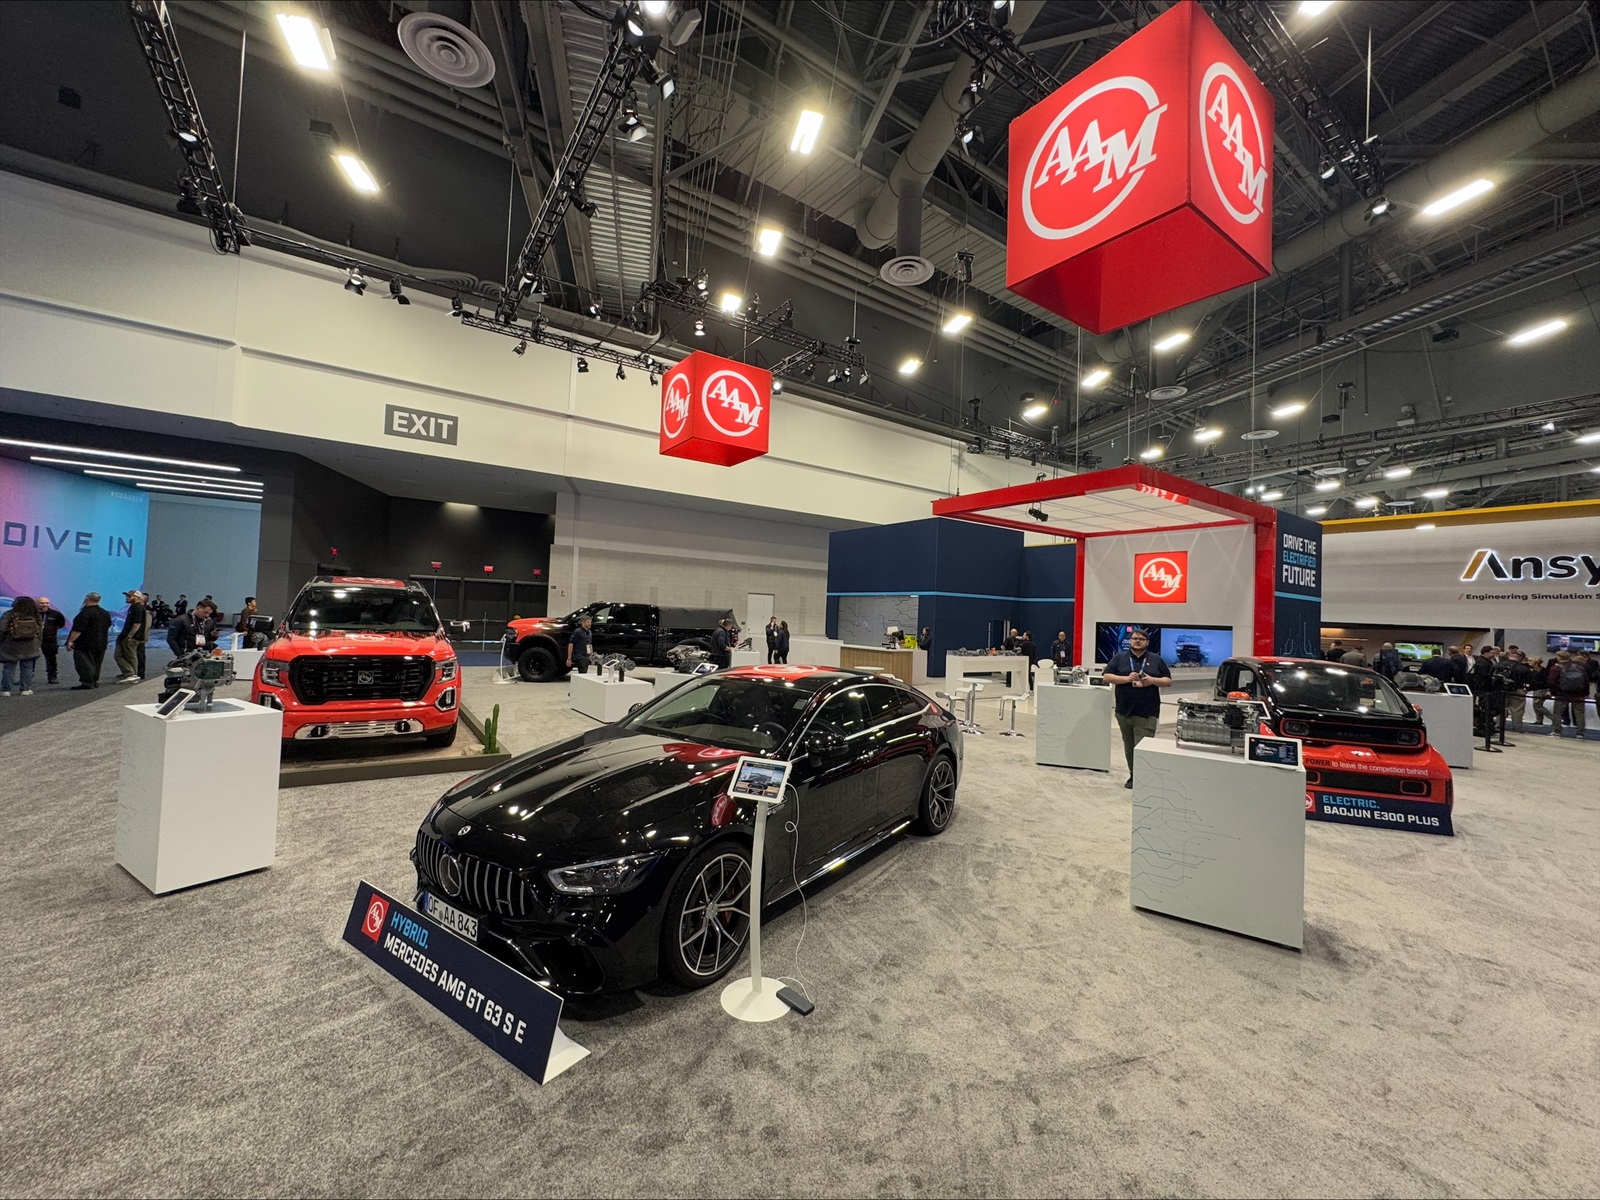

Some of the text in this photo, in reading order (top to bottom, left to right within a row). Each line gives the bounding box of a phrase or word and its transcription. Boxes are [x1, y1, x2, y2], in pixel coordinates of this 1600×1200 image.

[1034, 103, 1168, 193] AAM
[1207, 82, 1268, 214] AAM
[666, 387, 691, 422] AAM
[708, 379, 763, 427] AAM
[392, 410, 454, 439] EXIT
[3, 521, 133, 558] DIVE IN
[1283, 533, 1317, 555] DRIVE THE
[1283, 550, 1316, 567] ELECTRIFIED
[1143, 564, 1183, 589] AAM
[1282, 564, 1316, 588] FUTURE
[1466, 593, 1528, 601] Engineering
[1306, 757, 1330, 766] POWER
[1340, 761, 1356, 769] leave
[1357, 763, 1368, 771] the
[1369, 765, 1406, 775] competition
[1406, 767, 1429, 776] behind
[1322, 794, 1380, 809] ELECTRIC.
[1323, 805, 1440, 826] BAOJUN E300 PLUS
[391, 911, 429, 949] HYBRID.
[444, 906, 456, 927] AA
[457, 913, 477, 938] 843
[383, 933, 527, 1044] MERCEDES AMG GT 63 S E
